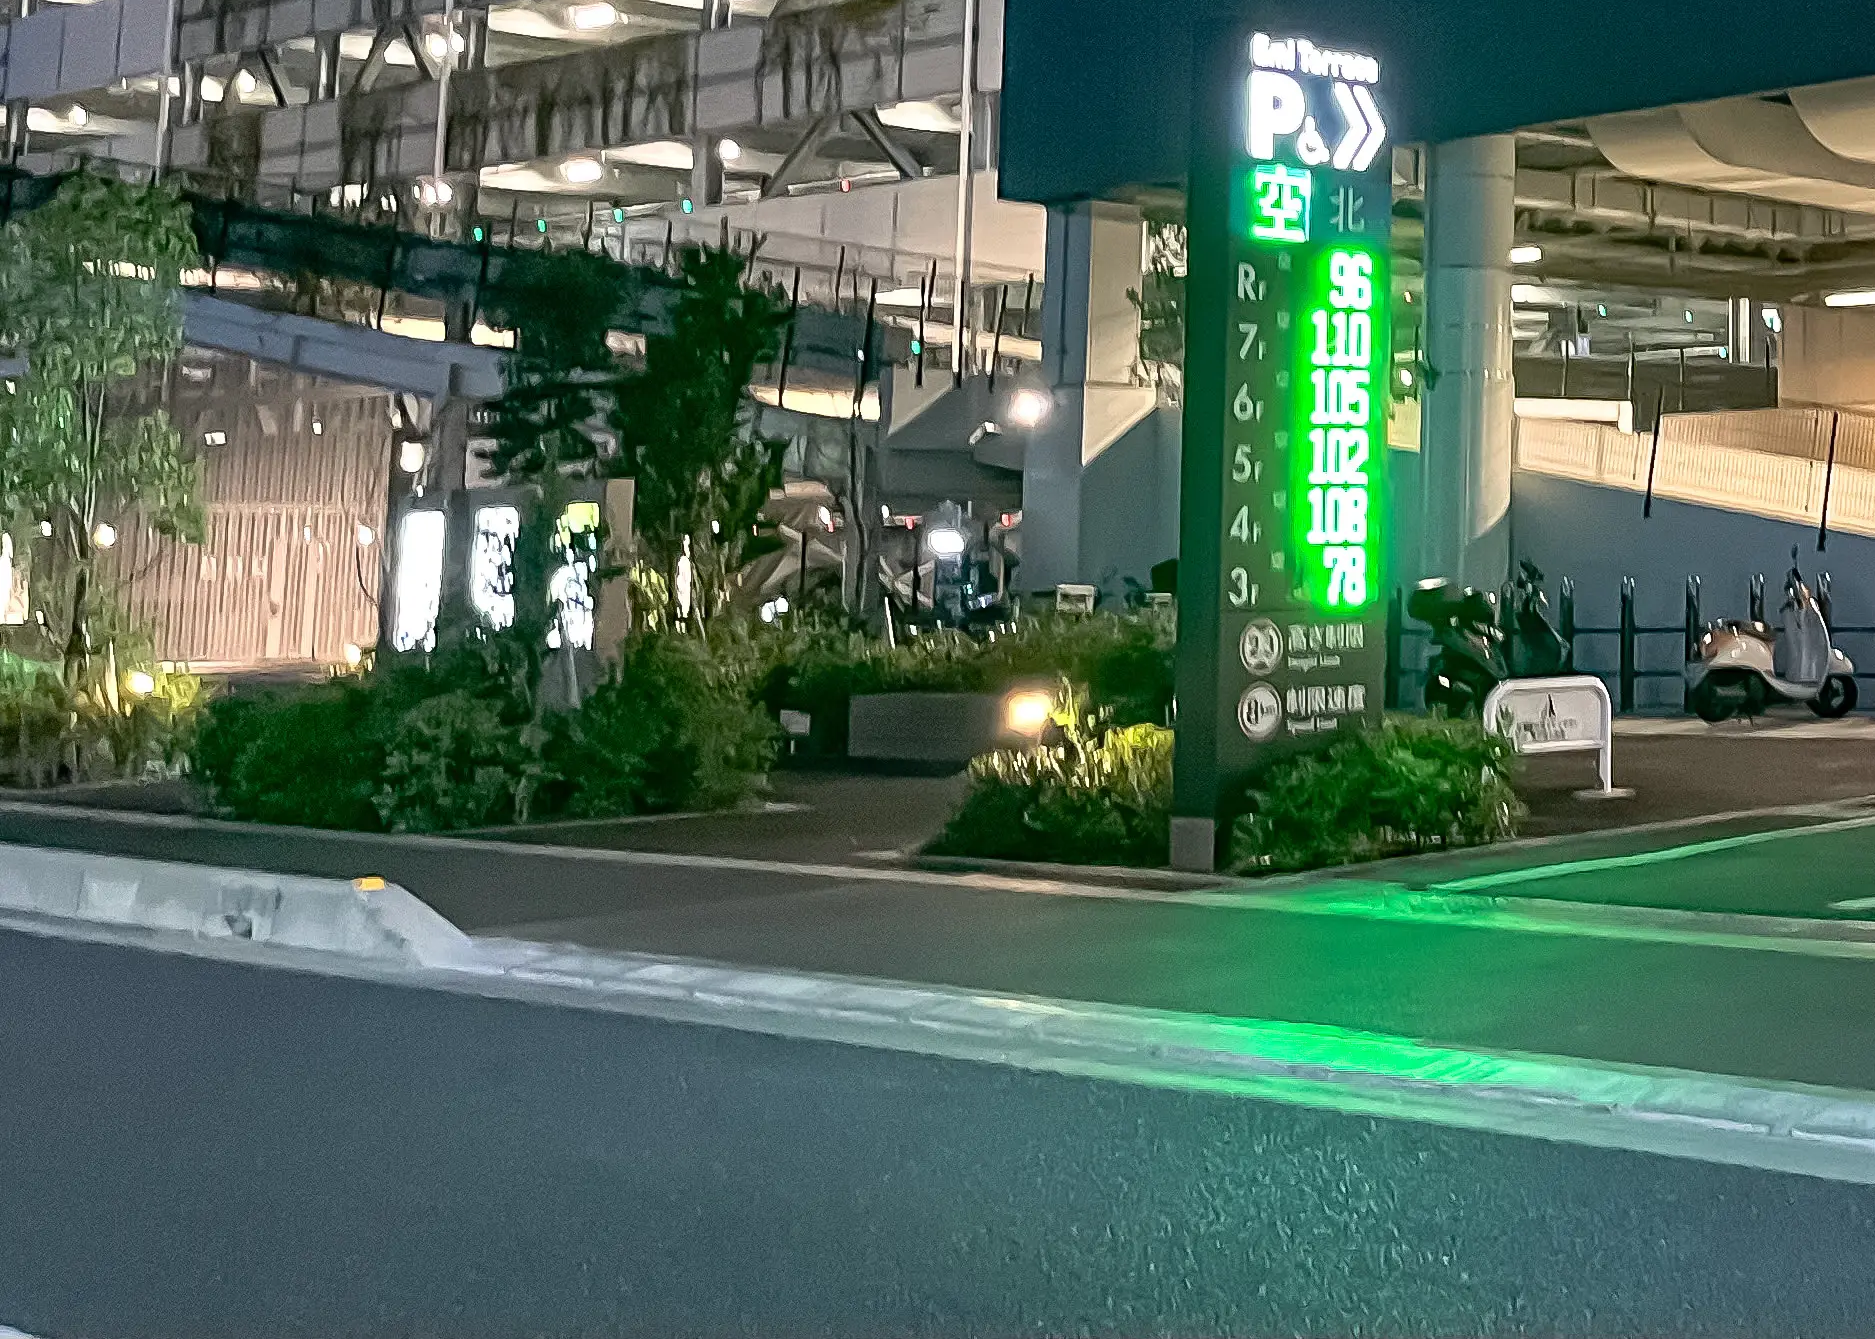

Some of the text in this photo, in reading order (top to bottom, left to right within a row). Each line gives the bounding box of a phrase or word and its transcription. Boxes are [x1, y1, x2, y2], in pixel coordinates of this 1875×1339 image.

[1248, 70, 1305, 160] P
[1253, 163, 1365, 243] 空 北
[1329, 250, 1373, 310] 96
[1311, 310, 1372, 368] 110
[1310, 368, 1371, 427] 105
[1308, 428, 1370, 485] 102
[1307, 486, 1368, 545] 108
[1323, 546, 1367, 607] 78
